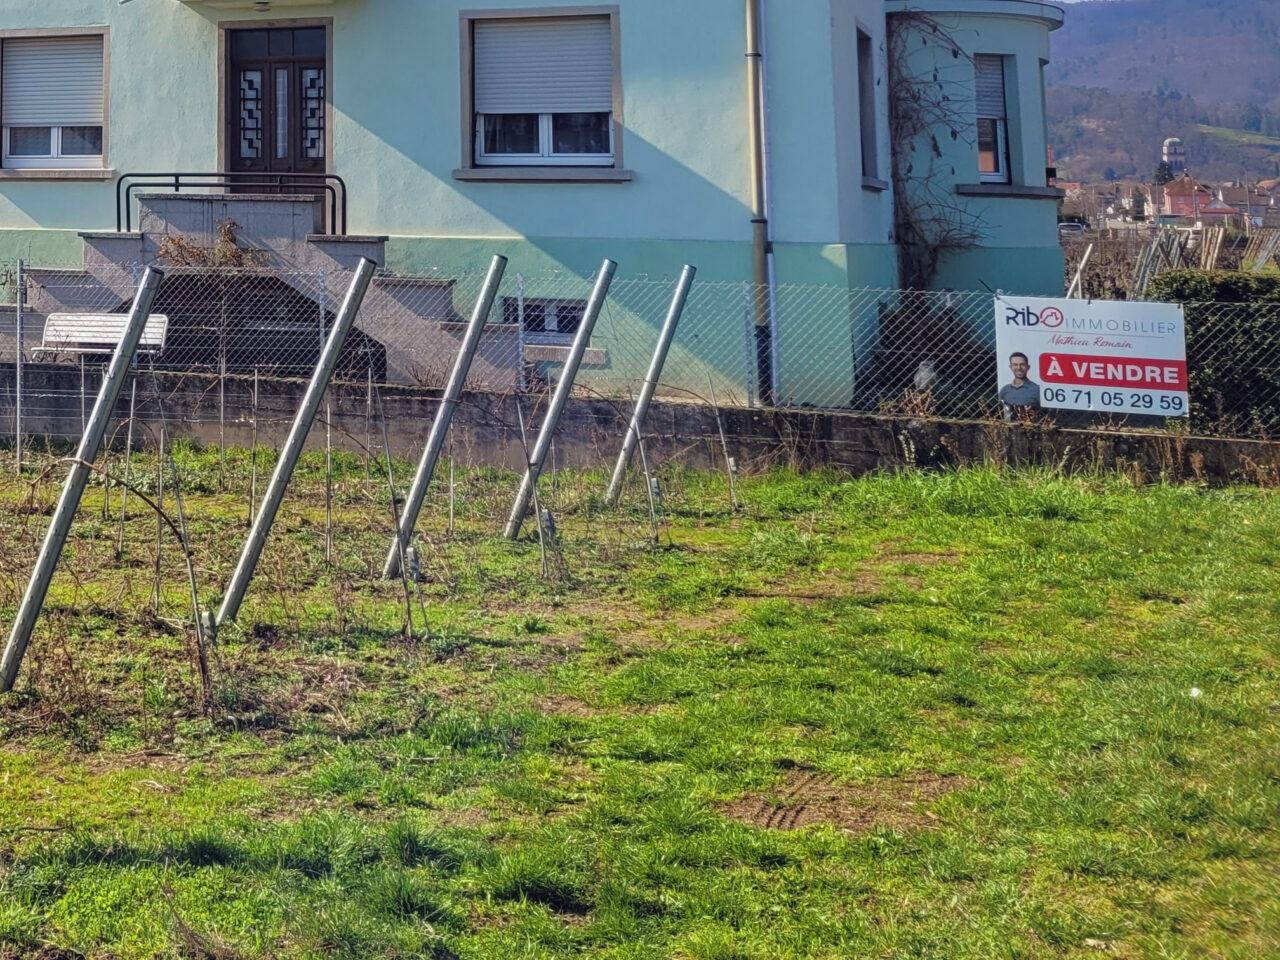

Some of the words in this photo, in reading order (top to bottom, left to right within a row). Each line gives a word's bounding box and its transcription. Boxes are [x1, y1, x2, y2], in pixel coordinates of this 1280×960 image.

[1065, 318, 1176, 334] IMMOBILIER
[1092, 337, 1133, 349] Romain
[1046, 356, 1063, 377] À
[1072, 361, 1179, 384] VENDRE
[1043, 387, 1066, 402] 06
[1072, 390, 1091, 404] 71
[1101, 391, 1124, 407] 05
[1130, 393, 1153, 409] 29
[1160, 395, 1183, 410] 59
